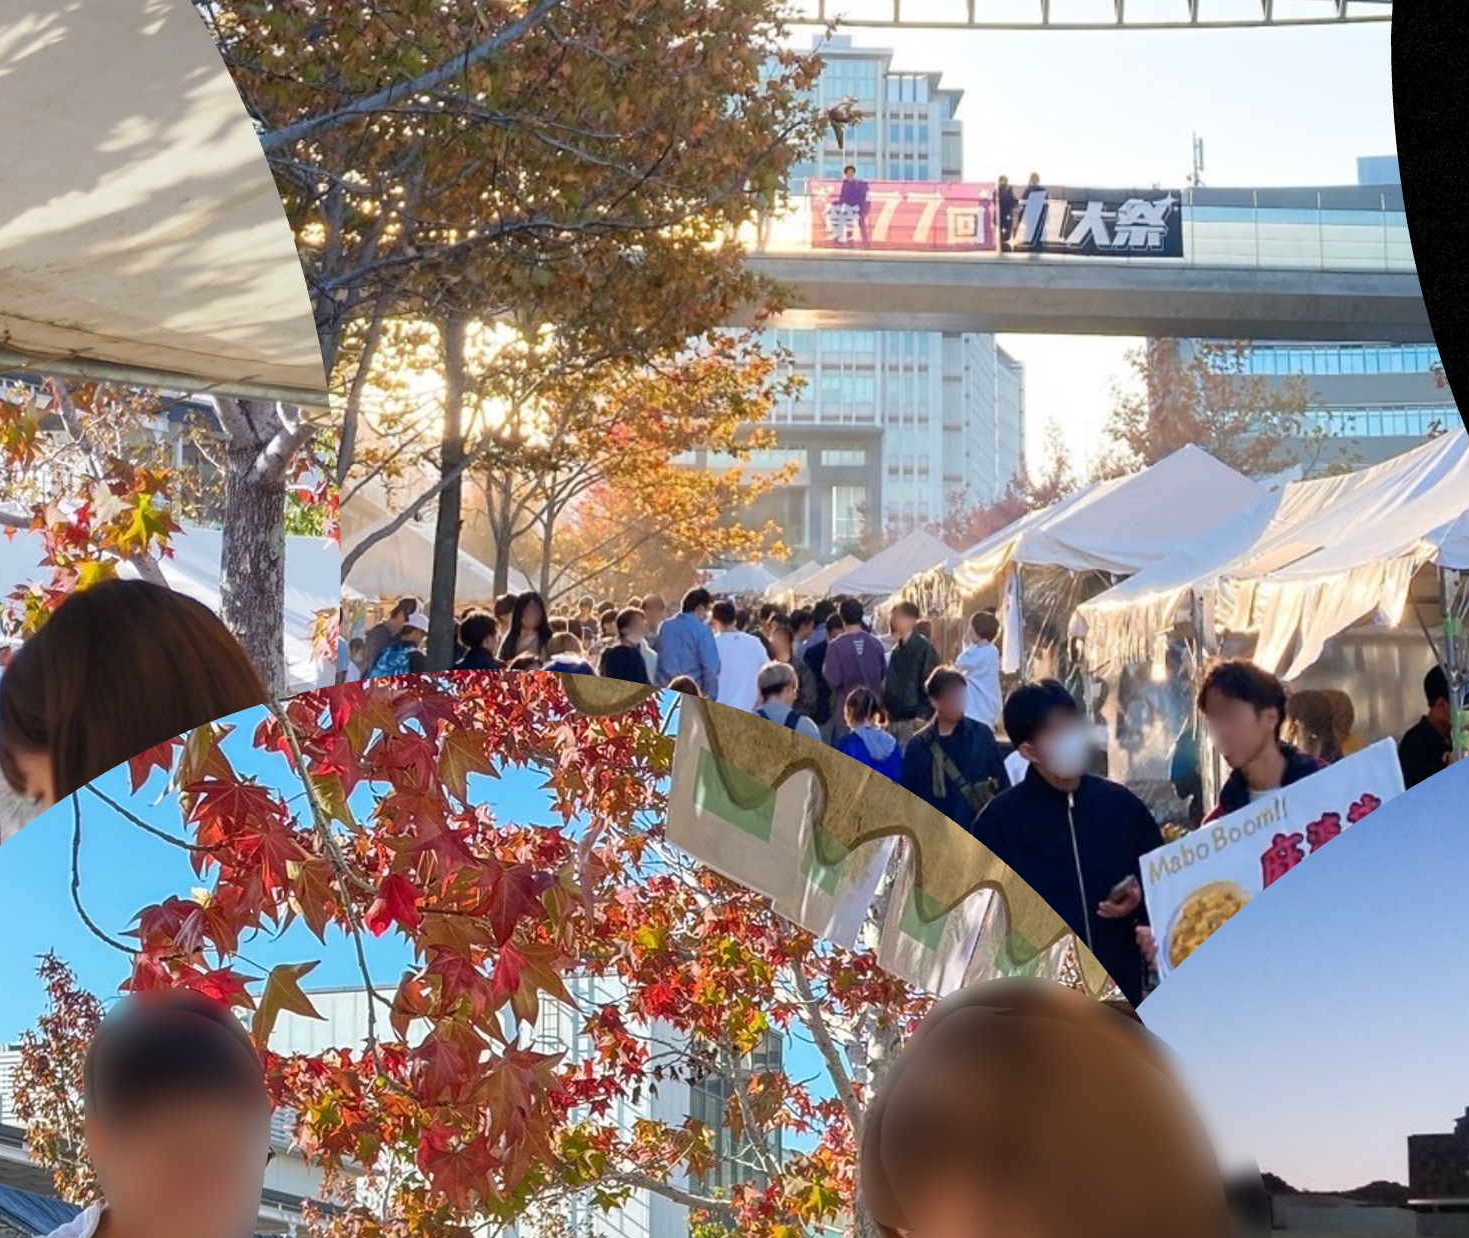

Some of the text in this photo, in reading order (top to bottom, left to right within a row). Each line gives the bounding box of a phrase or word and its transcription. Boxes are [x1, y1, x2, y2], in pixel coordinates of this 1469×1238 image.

[824, 191, 986, 245] 第77回
[1016, 190, 1170, 249] 九大祭
[1148, 796, 1288, 886] Mabo Boom!!
